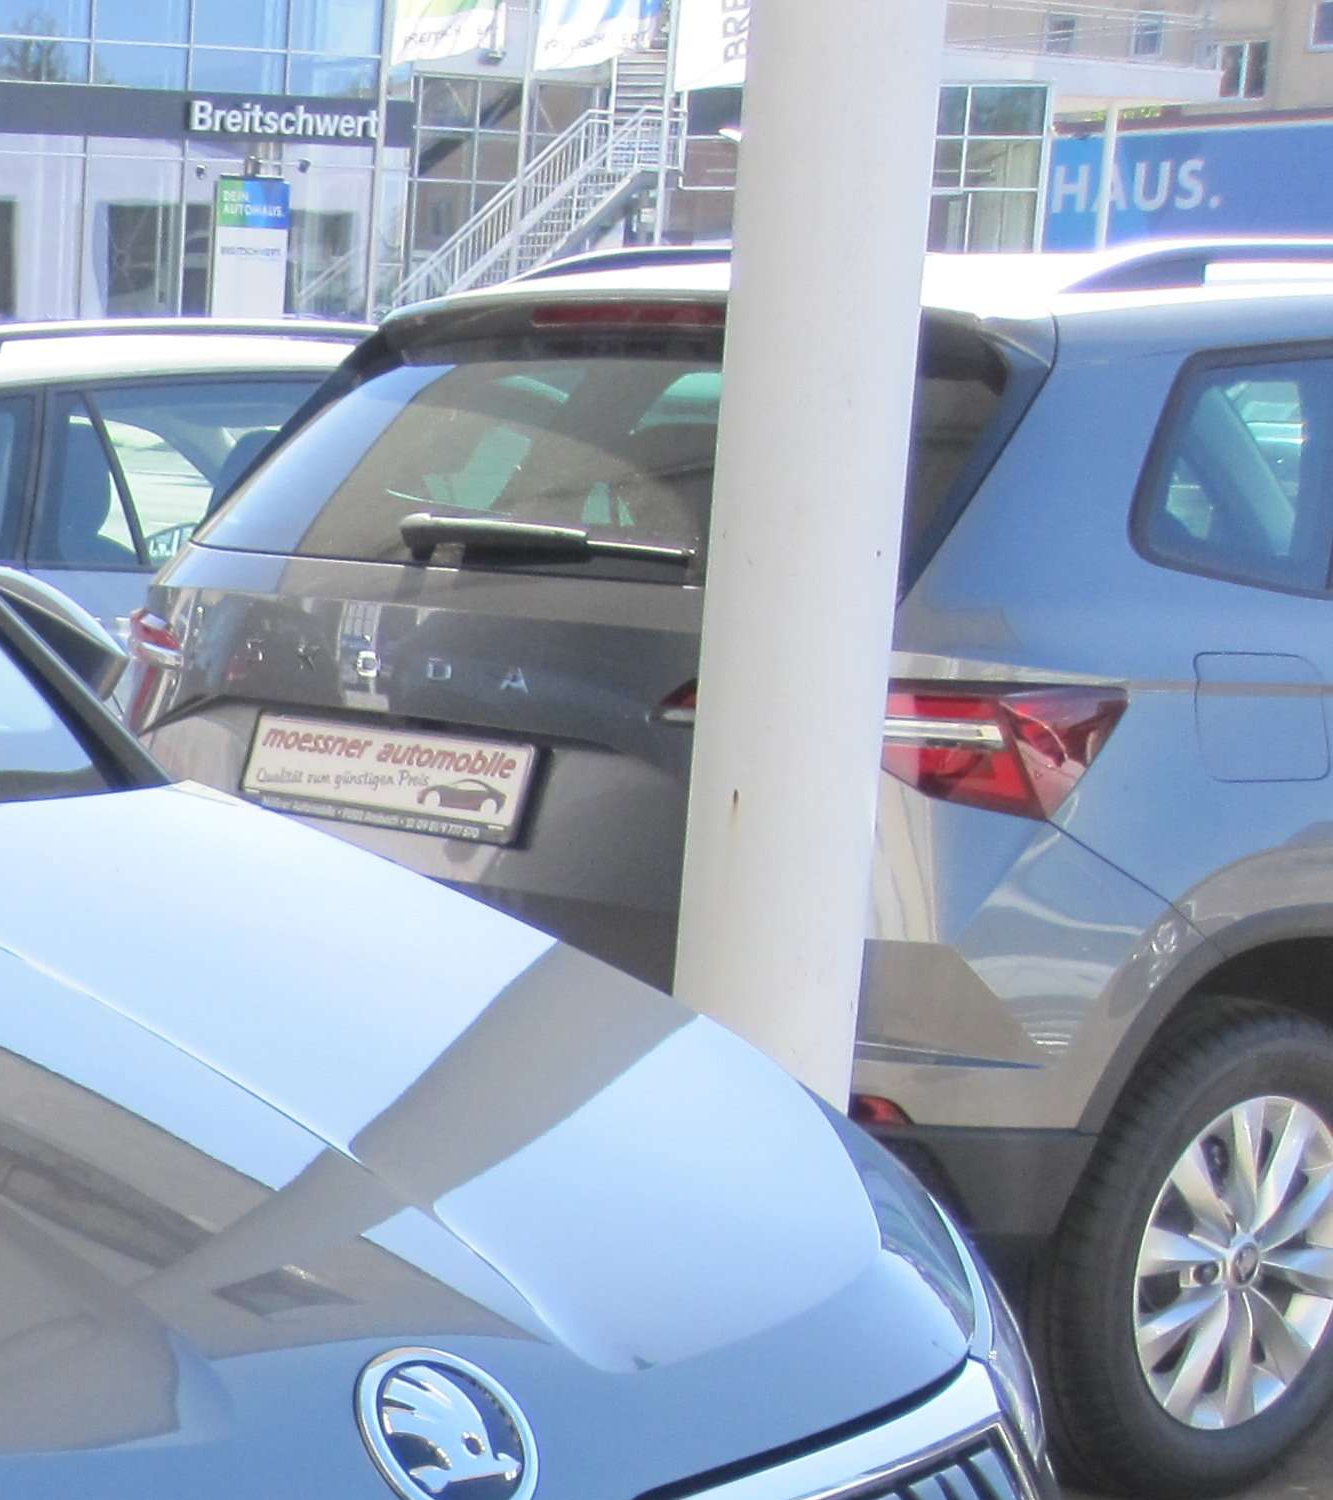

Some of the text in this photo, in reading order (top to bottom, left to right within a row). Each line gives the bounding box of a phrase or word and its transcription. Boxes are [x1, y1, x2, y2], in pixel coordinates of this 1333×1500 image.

[190, 100, 378, 138] Breitschwert
[262, 727, 517, 779] moessner automobile
[398, 769, 429, 787] Preis
